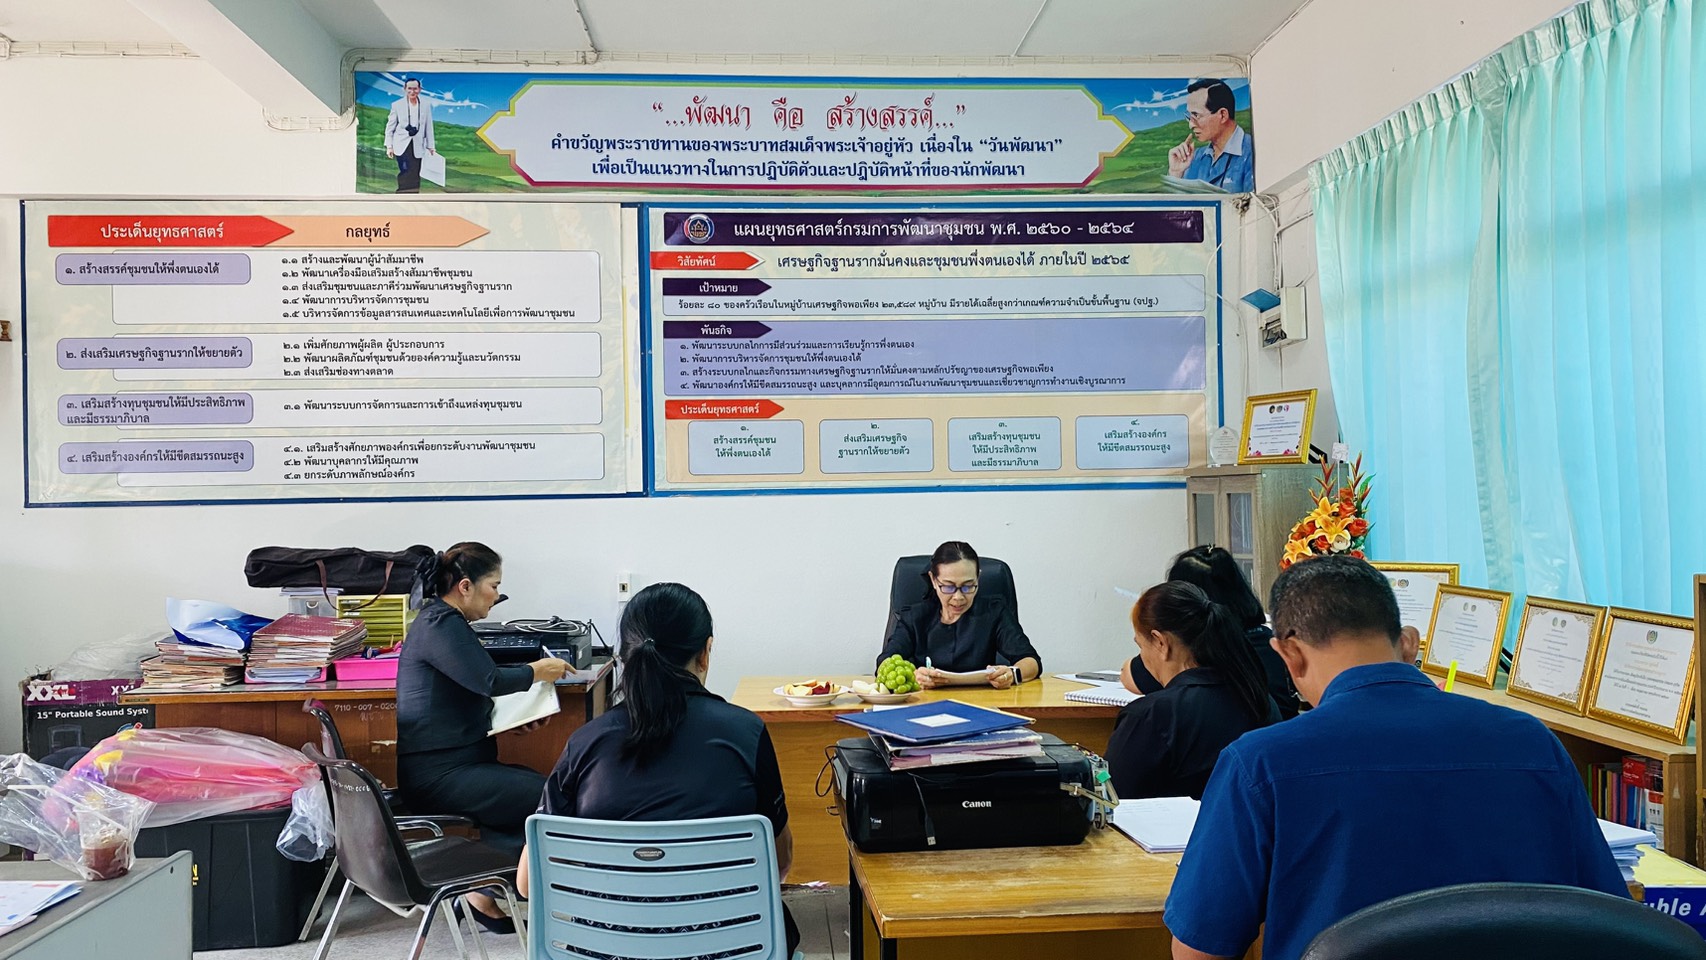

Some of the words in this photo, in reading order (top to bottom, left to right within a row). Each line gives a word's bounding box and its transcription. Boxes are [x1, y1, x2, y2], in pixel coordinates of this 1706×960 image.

[550, 133, 914, 157] คำขวัญพระราชทานของพระบาทสมเด็จพระเจ้าอยู่หัว
[919, 133, 974, 153] เนื่องใน
[979, 136, 1063, 153] “วันพัฒนา”
[591, 157, 1026, 182] เพื่อเป็นแนวทางในการปฏิบัติตัวและปฏิบัติหน้าที่ของนักพัฒนา
[100, 221, 224, 242] ประเด็นยุทธศาสตร์
[346, 222, 390, 242] กลยุทธ์
[734, 218, 984, 240] แผนยุทธศาสตร์กรมการพัฒนาชุมชน
[990, 223, 1020, 235] พ.ศ.
[1026, 221, 1071, 235] ๒๕๖๐
[1088, 221, 1134, 234] ๒๕๖๔
[282, 256, 298, 265] ๑.๑
[301, 254, 424, 267] สร้างและพัฒนาผู้นำสัมมาชีพ
[678, 255, 716, 267] วิสัยทัศน์
[777, 251, 1035, 270] เศรษฐกิจฐานรากมั่นคงและชุมชนพึ่งตนเองได้
[1040, 251, 1086, 266] ภายในปี
[65, 265, 76, 276] ๑.
[79, 261, 219, 277] สร้างสรรค์ชุมชนให้พึ่งตนเองได้
[302, 267, 472, 280] พัฒนาเครื่องมือเสริมสร้างสัมมาชีพชุมชน
[302, 280, 512, 294] ส่งเสริมชุมชนและภาคีร่วมพัฒนาเศรษฐกิจฐานราก
[699, 282, 738, 293] เป้าหมาย
[302, 295, 429, 307] พัฒนาการบริหารจัดการชุมชน
[678, 299, 704, 308] ร้อยละ
[724, 299, 879, 312] ของครัวเรือนในหมู่บ้านเศรษฐกิจพอเพียง
[919, 299, 946, 310] หมู่บ้าน
[949, 294, 1130, 310] มีรายได้เฉลี่ยสูงกว่าเกณฑ์ความจำเป็นขั้นพื้นฐาน
[1133, 297, 1159, 307] (จปฐ.)
[302, 307, 575, 320] บริหารจัดการข้อมูลสารสนเทศและเทคโนโลยีเพื่อการพัฒนาชุมชน
[701, 324, 732, 335] พันธกิจ
[303, 336, 383, 351] เพิ่มศักยภาพผู้ผลิต
[386, 339, 444, 351] ผู้ประกอบการ
[692, 339, 914, 352] พัฒนาระบบกลไกการมีส่วนร่วมและการเรียนรู้การพึ่งตนเอง
[66, 350, 77, 360] ๒.
[80, 346, 243, 362] ส่งเสริมเศรษฐกิจฐานรากให้ขยายตัว
[304, 352, 520, 365] พัฒนาผลิตภัณฑ์ชุมชนด้วยองค์ความรู้และนวัตกรรม
[692, 351, 862, 365] พัฒนาการบริหารจัดการชุมชนให้พึ่งตนเองได้
[304, 366, 394, 377] ส่งเสริมช่องทางตลาด
[692, 378, 817, 390] พัฒนาองค์กรให้มีขีดสมรรถนะสูง
[81, 396, 245, 411] เสริมสร้างทุนชุมชนให้มีประสิทธิภาพ
[304, 399, 522, 413] พัฒนาระบบการจัดการและการเข้าถึงแหล่งทุนชุมชน
[681, 403, 760, 415] ประเด็นยุทธศาสตร์
[67, 413, 150, 424] และมีธรรมาภิบาล
[713, 434, 776, 446] สร้างสรรค์ชุมชน
[843, 433, 907, 445] ส่งเสริมเศรษฐกิจ
[969, 431, 1040, 442] เสริมสร้างทุนชุมชน
[1104, 430, 1166, 439] เสริมสร้างองค์กร
[306, 438, 536, 454] เสริมสร้างศักยภาพองค์กรเพื่อยกระดับงานพัฒนาชุมชน
[716, 447, 771, 458] ให้พึ่งตนเองได้
[838, 446, 910, 458] ฐานรากให้ขยายตัว
[973, 444, 1036, 454] ให้มีประสิทธิภาพ
[1098, 443, 1170, 454] ให้มีขีดสมรรถนะสูง
[82, 448, 244, 465] เสริมสร้างองค์กรให้มีขีดสมรรถนะสูง
[304, 453, 418, 468] พัฒนาบุคลากรให้มีคุณภาพ
[972, 457, 1038, 466] และมีธรรมาภิบาล
[304, 467, 415, 481] ยกระดับภาพลักษณ์องค์กร
[27, 684, 76, 701] XXL
[55, 710, 93, 718] Portable
[96, 708, 124, 716] Sound
[962, 800, 992, 808] Canon
